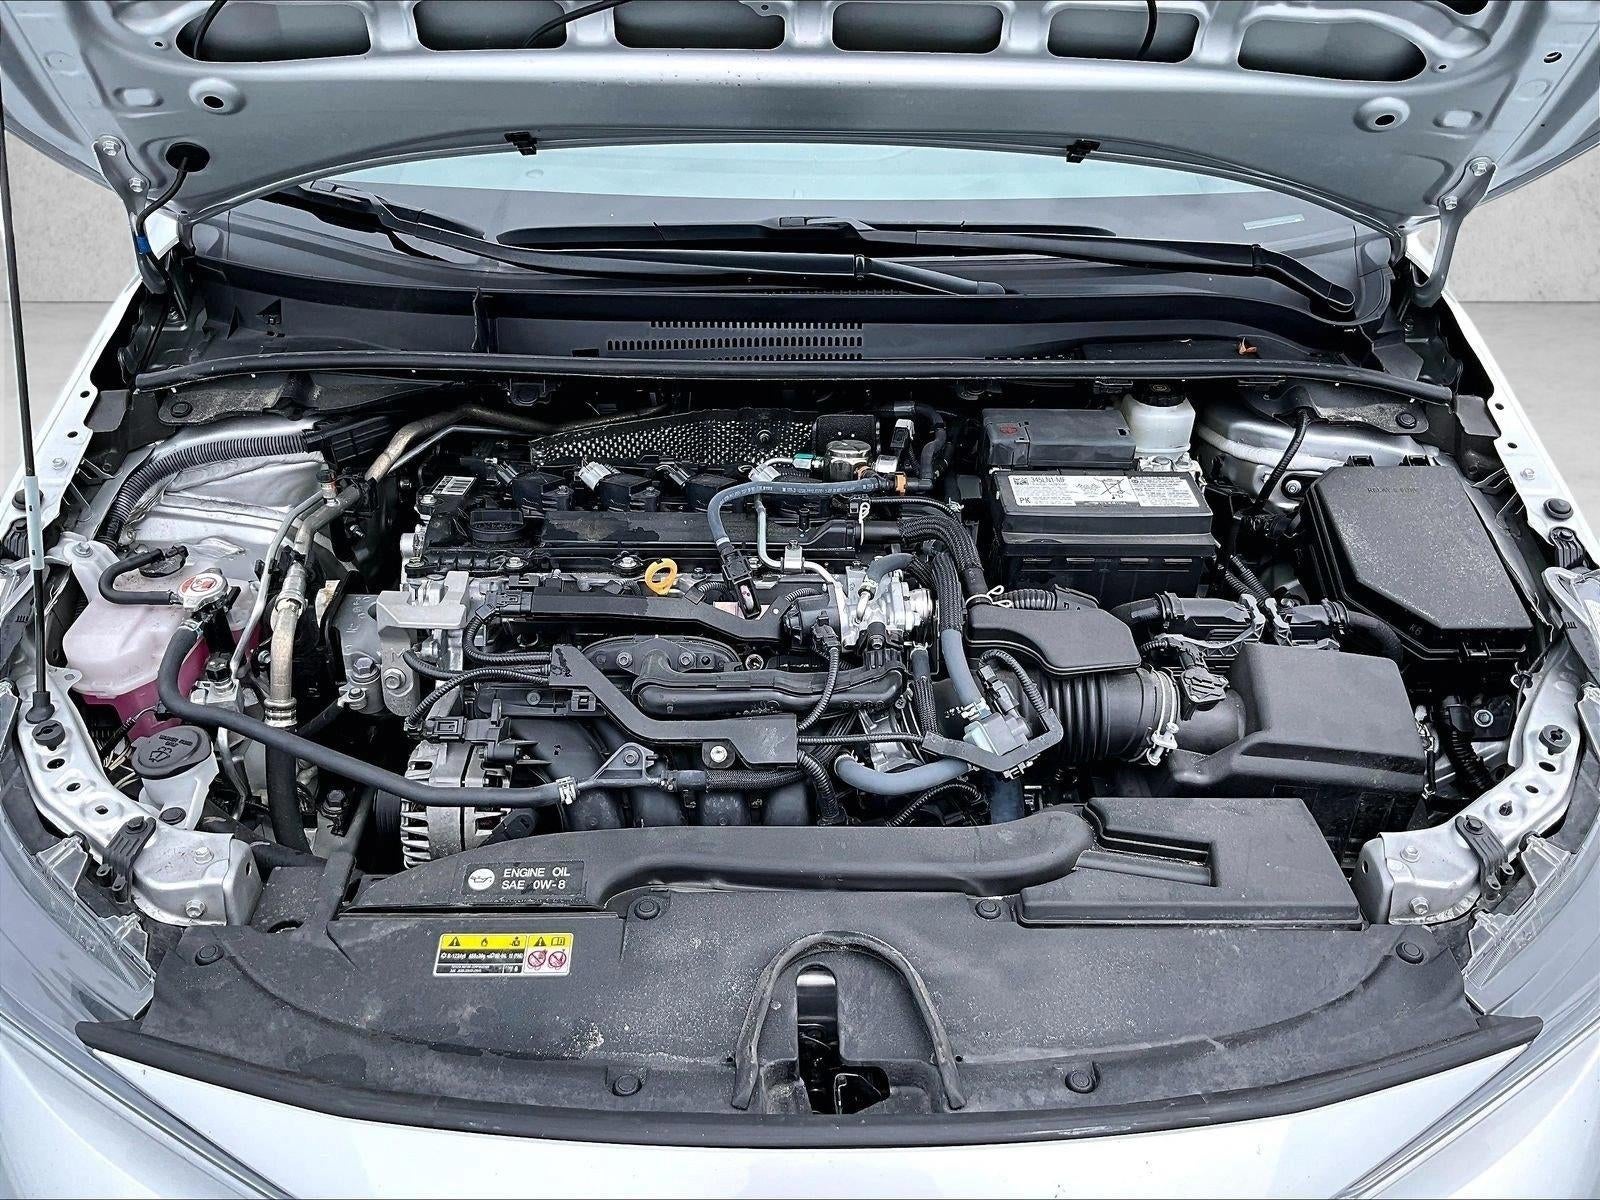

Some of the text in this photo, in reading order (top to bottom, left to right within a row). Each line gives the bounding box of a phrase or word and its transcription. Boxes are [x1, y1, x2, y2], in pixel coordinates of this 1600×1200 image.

[503, 866, 571, 878] ENGINE OIL
[501, 879, 566, 890] SAE 0W-8
